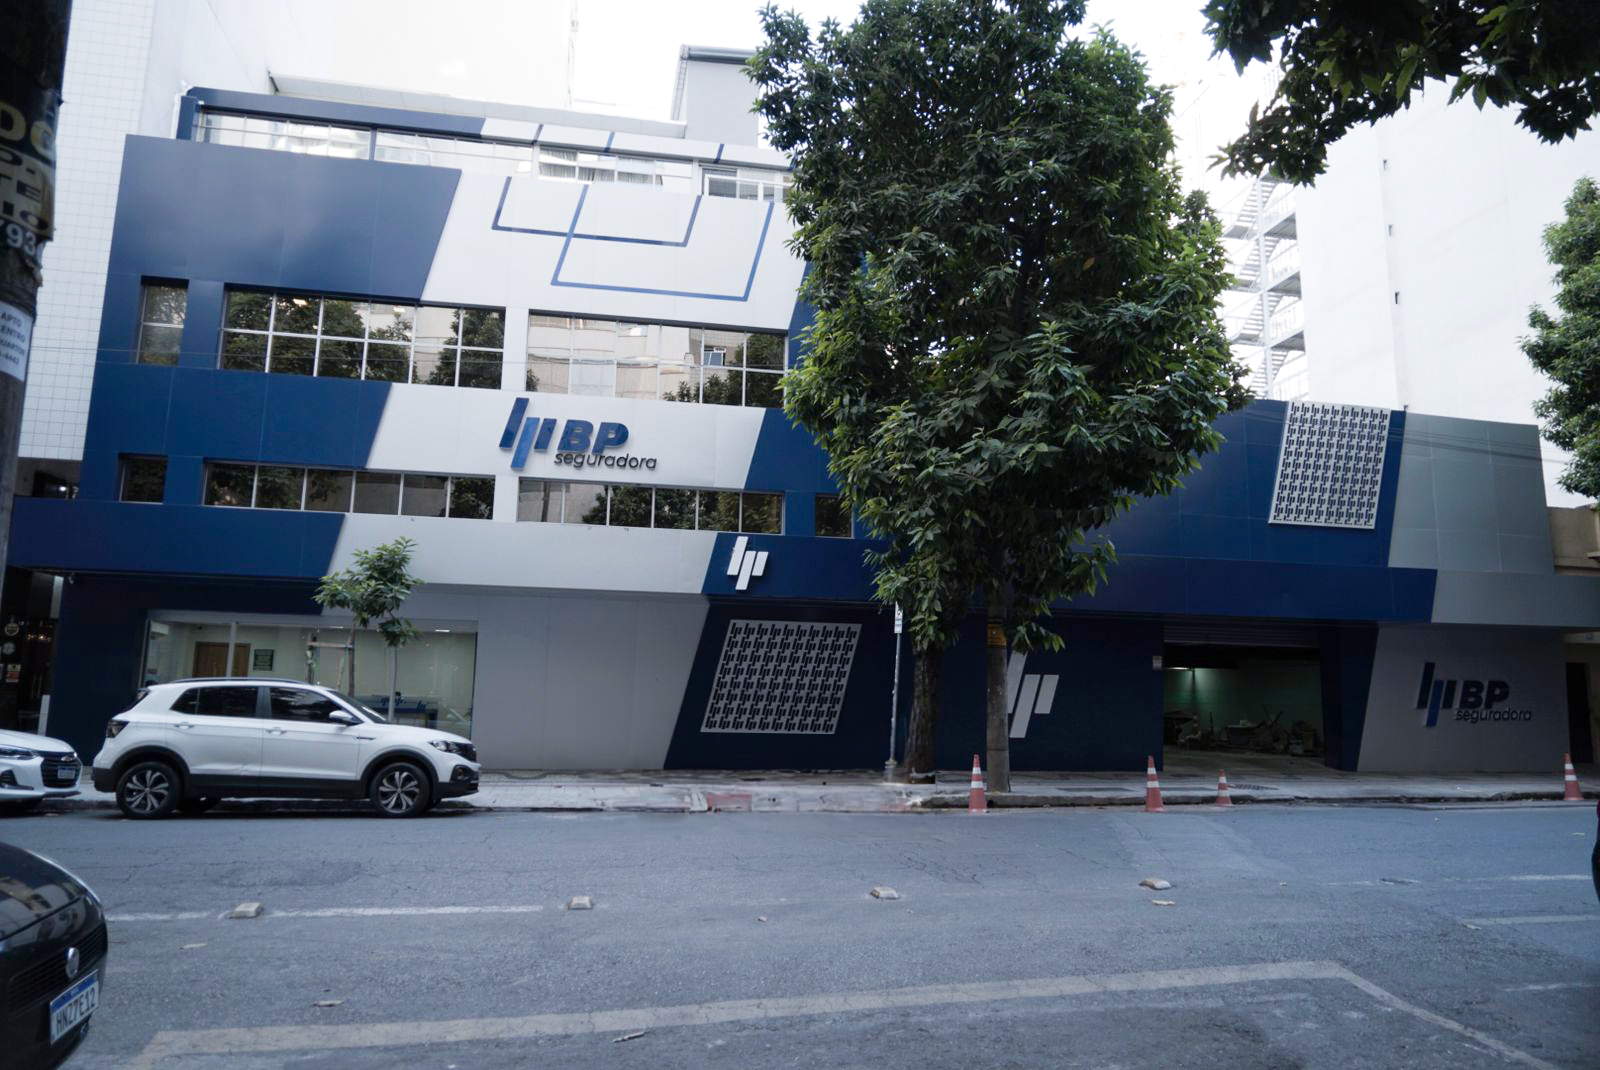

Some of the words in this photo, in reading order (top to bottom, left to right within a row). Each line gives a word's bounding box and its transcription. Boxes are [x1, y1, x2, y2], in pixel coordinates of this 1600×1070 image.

[557, 419, 629, 454] BP
[554, 452, 658, 471] seguradora
[1458, 679, 1510, 710] BP
[1455, 707, 1532, 724] seguradora
